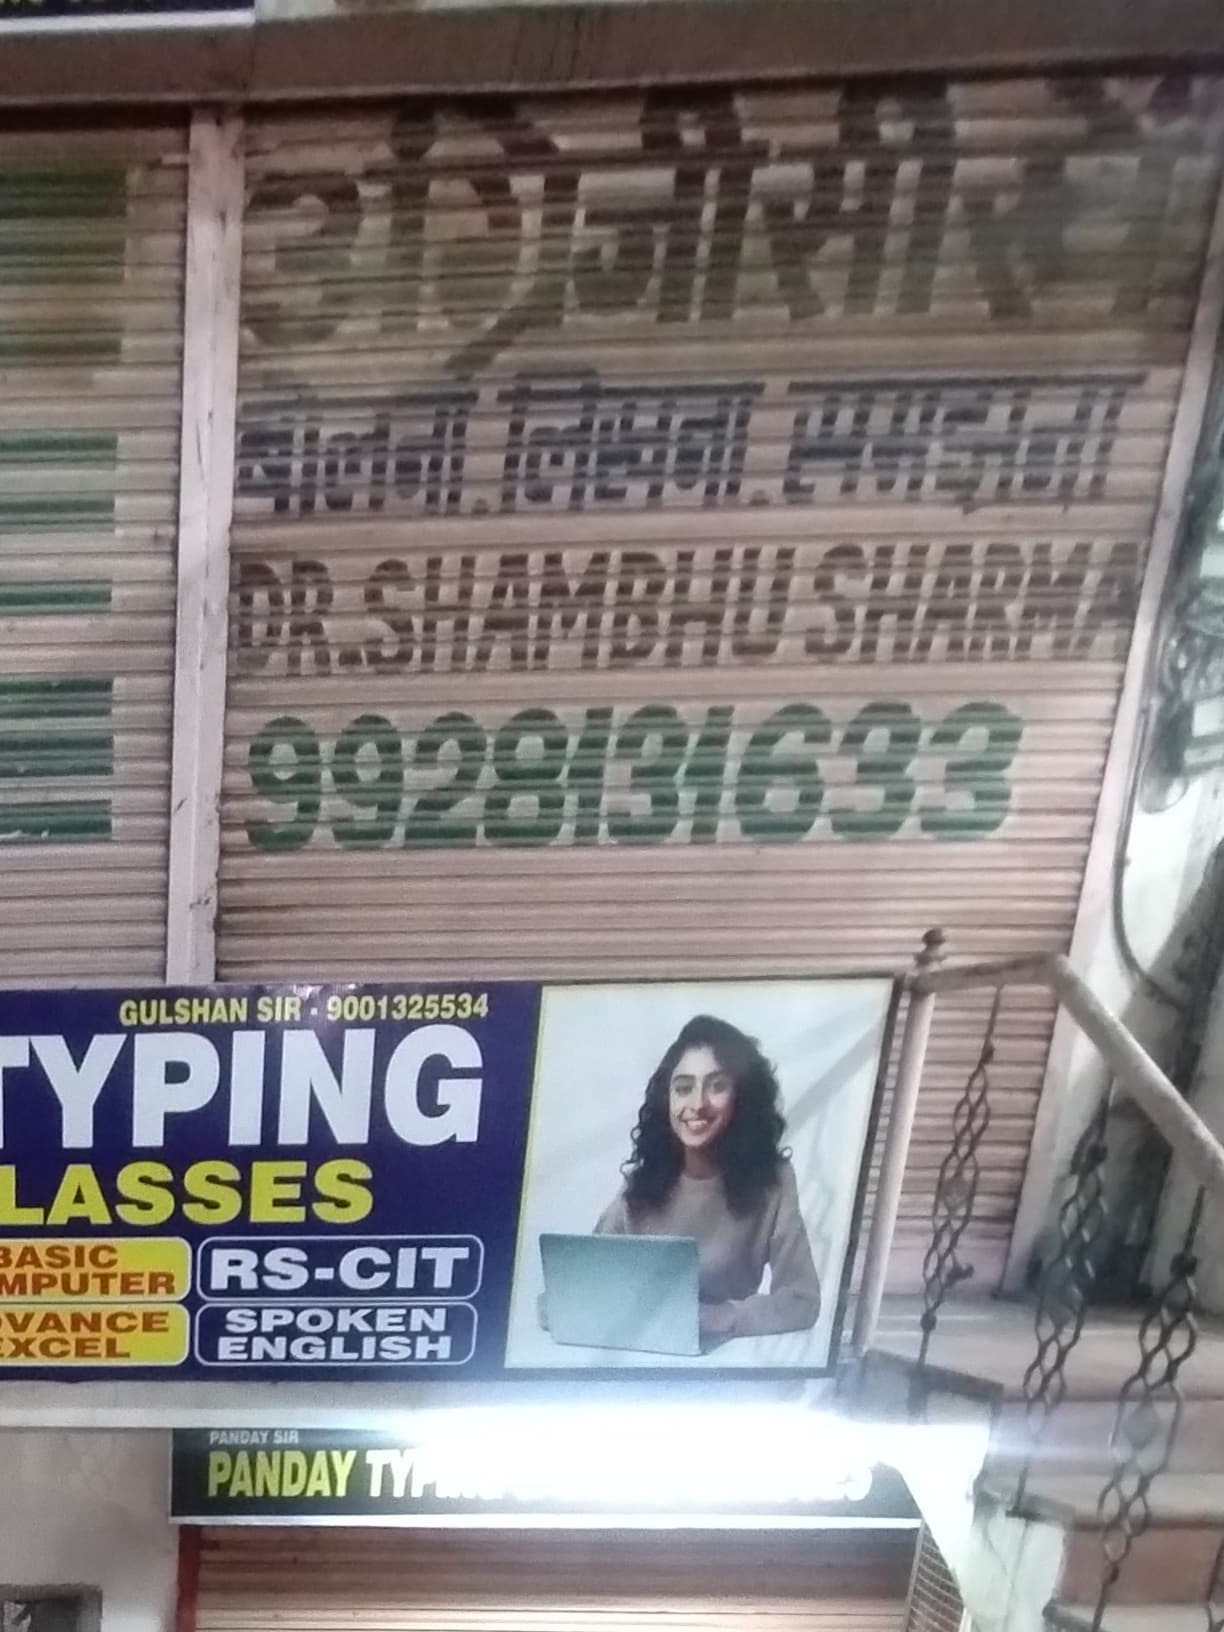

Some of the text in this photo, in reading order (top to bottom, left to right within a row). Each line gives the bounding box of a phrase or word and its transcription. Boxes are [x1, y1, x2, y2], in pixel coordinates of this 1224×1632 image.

[247, 701, 1024, 850] 9928131633
[120, 999, 247, 1026] GULSHAN
[257, 997, 299, 1022] SIR
[327, 994, 488, 1022] 9001325534
[211, 1247, 469, 1290] RS-CIT
[226, 1308, 446, 1333] SPOKEN
[217, 1335, 451, 1360] ENGLISH
[210, 1429, 299, 1445] PANDAY SIR
[208, 1450, 356, 1497] PANDAY
